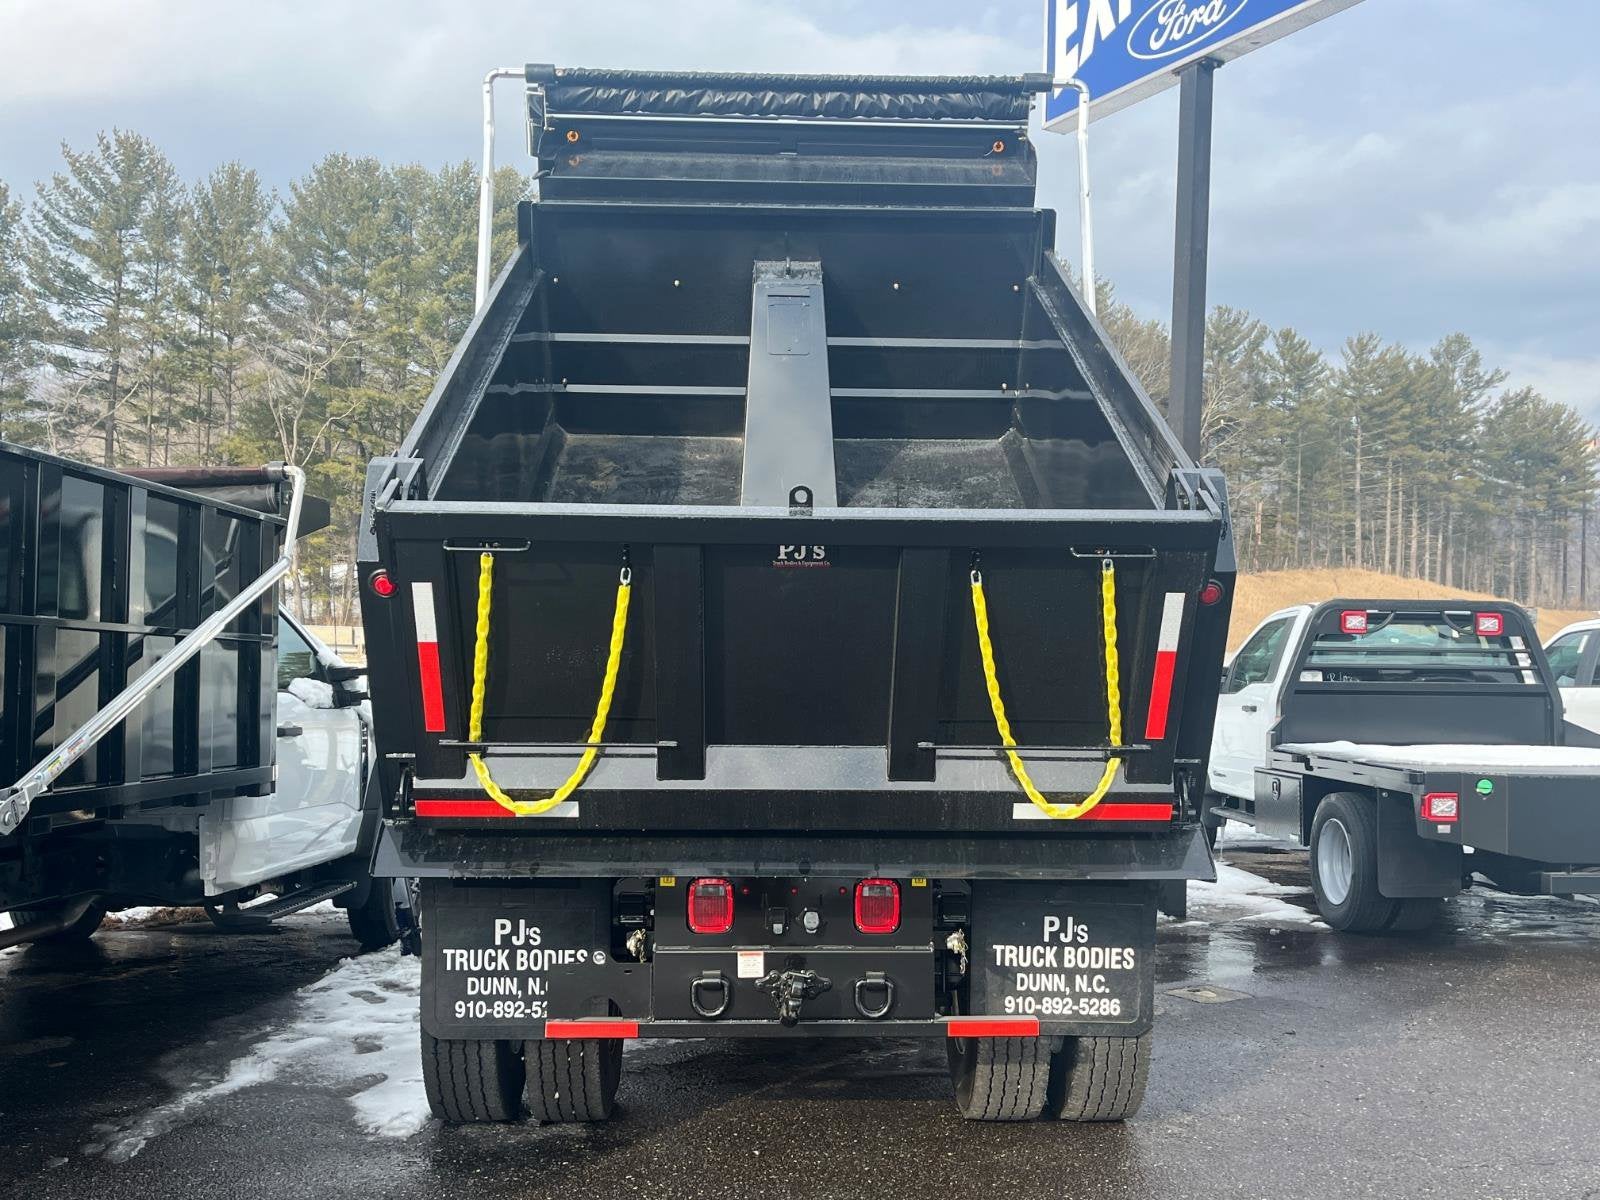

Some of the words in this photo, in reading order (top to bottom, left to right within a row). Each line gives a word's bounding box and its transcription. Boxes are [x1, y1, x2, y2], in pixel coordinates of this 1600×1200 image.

[1149, 0, 1227, 50] Ford
[494, 918, 542, 946] PJ's
[1043, 915, 1089, 943] PJ's
[443, 948, 510, 971] TRUCK
[516, 948, 588, 971] BODIES
[993, 944, 1058, 968] TRUCK
[1063, 946, 1135, 969] BODIES
[467, 976, 522, 998] DUNN,
[528, 976, 548, 995] N.
[1016, 972, 1070, 995] DUNN,
[1075, 974, 1110, 993] N.C.
[1004, 995, 1121, 1016] 910-892-5286
